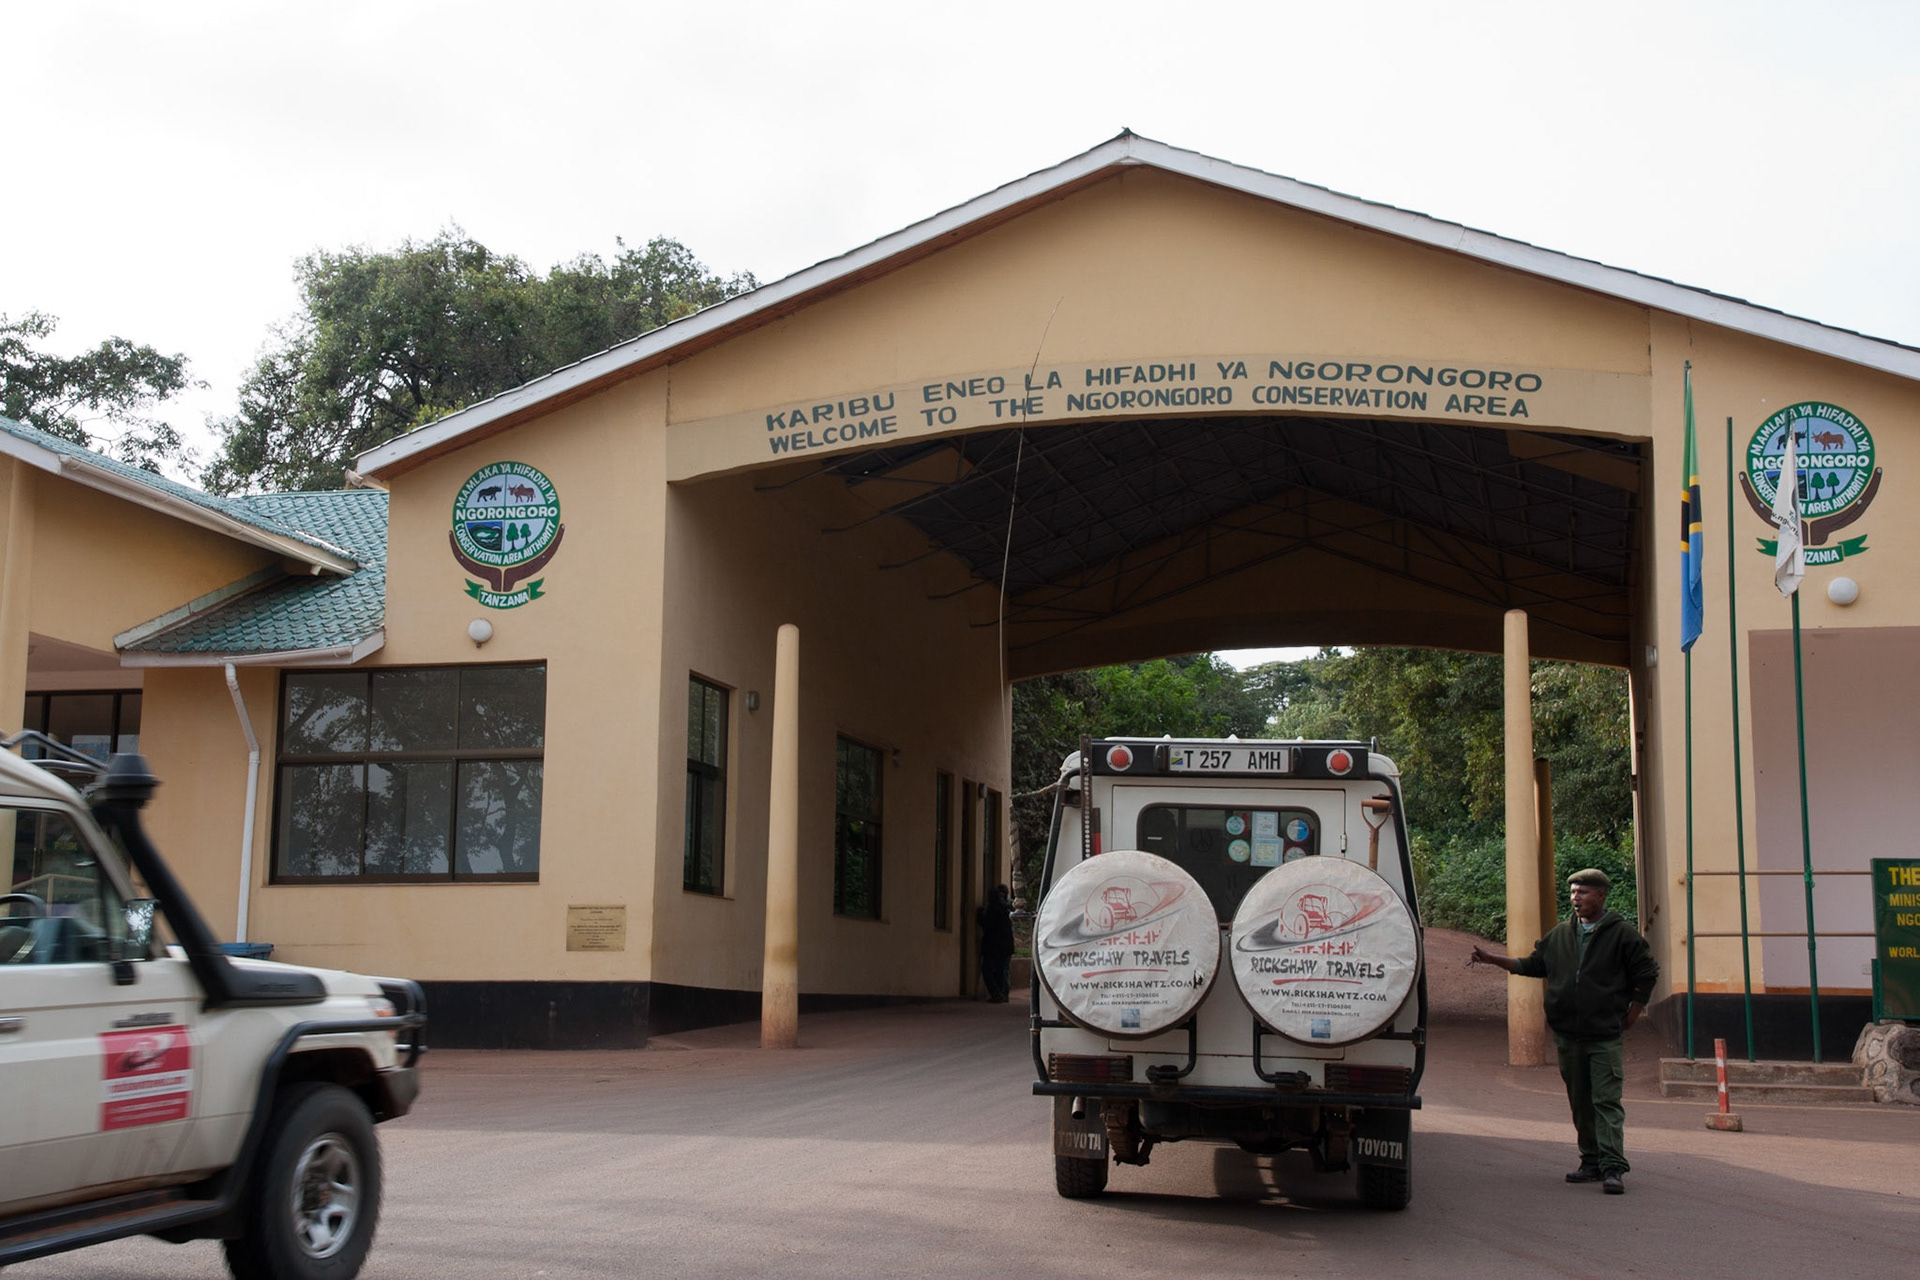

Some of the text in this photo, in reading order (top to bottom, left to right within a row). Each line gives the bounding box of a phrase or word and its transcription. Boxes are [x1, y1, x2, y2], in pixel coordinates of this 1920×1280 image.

[765, 361, 1542, 432] KARIBU ENEO LA HIFADHI YA NGORONGORO
[769, 386, 1529, 455] WELCOME TO THE NGORONGORO CONSERVATION AREA
[1798, 404, 1813, 417] YA
[1816, 405, 1863, 441] HIFADHI
[1857, 436, 1871, 453] YA
[1752, 454, 1870, 470] NGONGORO
[456, 463, 557, 508] MAMLAKA YA HIFADHI YA
[1807, 500, 1833, 515] AREA
[1832, 469, 1868, 510] AUTHORITY
[455, 506, 558, 521] NGORONGORO
[455, 519, 556, 565] CONSERVATION AREA AUTHORITY
[480, 591, 529, 607] TANZANIA
[1184, 750, 1281, 770] T 257 AMH
[1888, 867, 1920, 886] THE
[1059, 949, 1190, 968] RICKSHAW TRAVELS
[1251, 956, 1385, 979] RICKSHAW TRAVELS
[1069, 979, 1193, 990] WWW.RICKSHAWTZ.COM
[1260, 987, 1387, 1002] WWW.RICKSHAWTZ.COM
[1058, 1131, 1101, 1150] TOYOTA
[1357, 1137, 1403, 1160] TOYOTA
